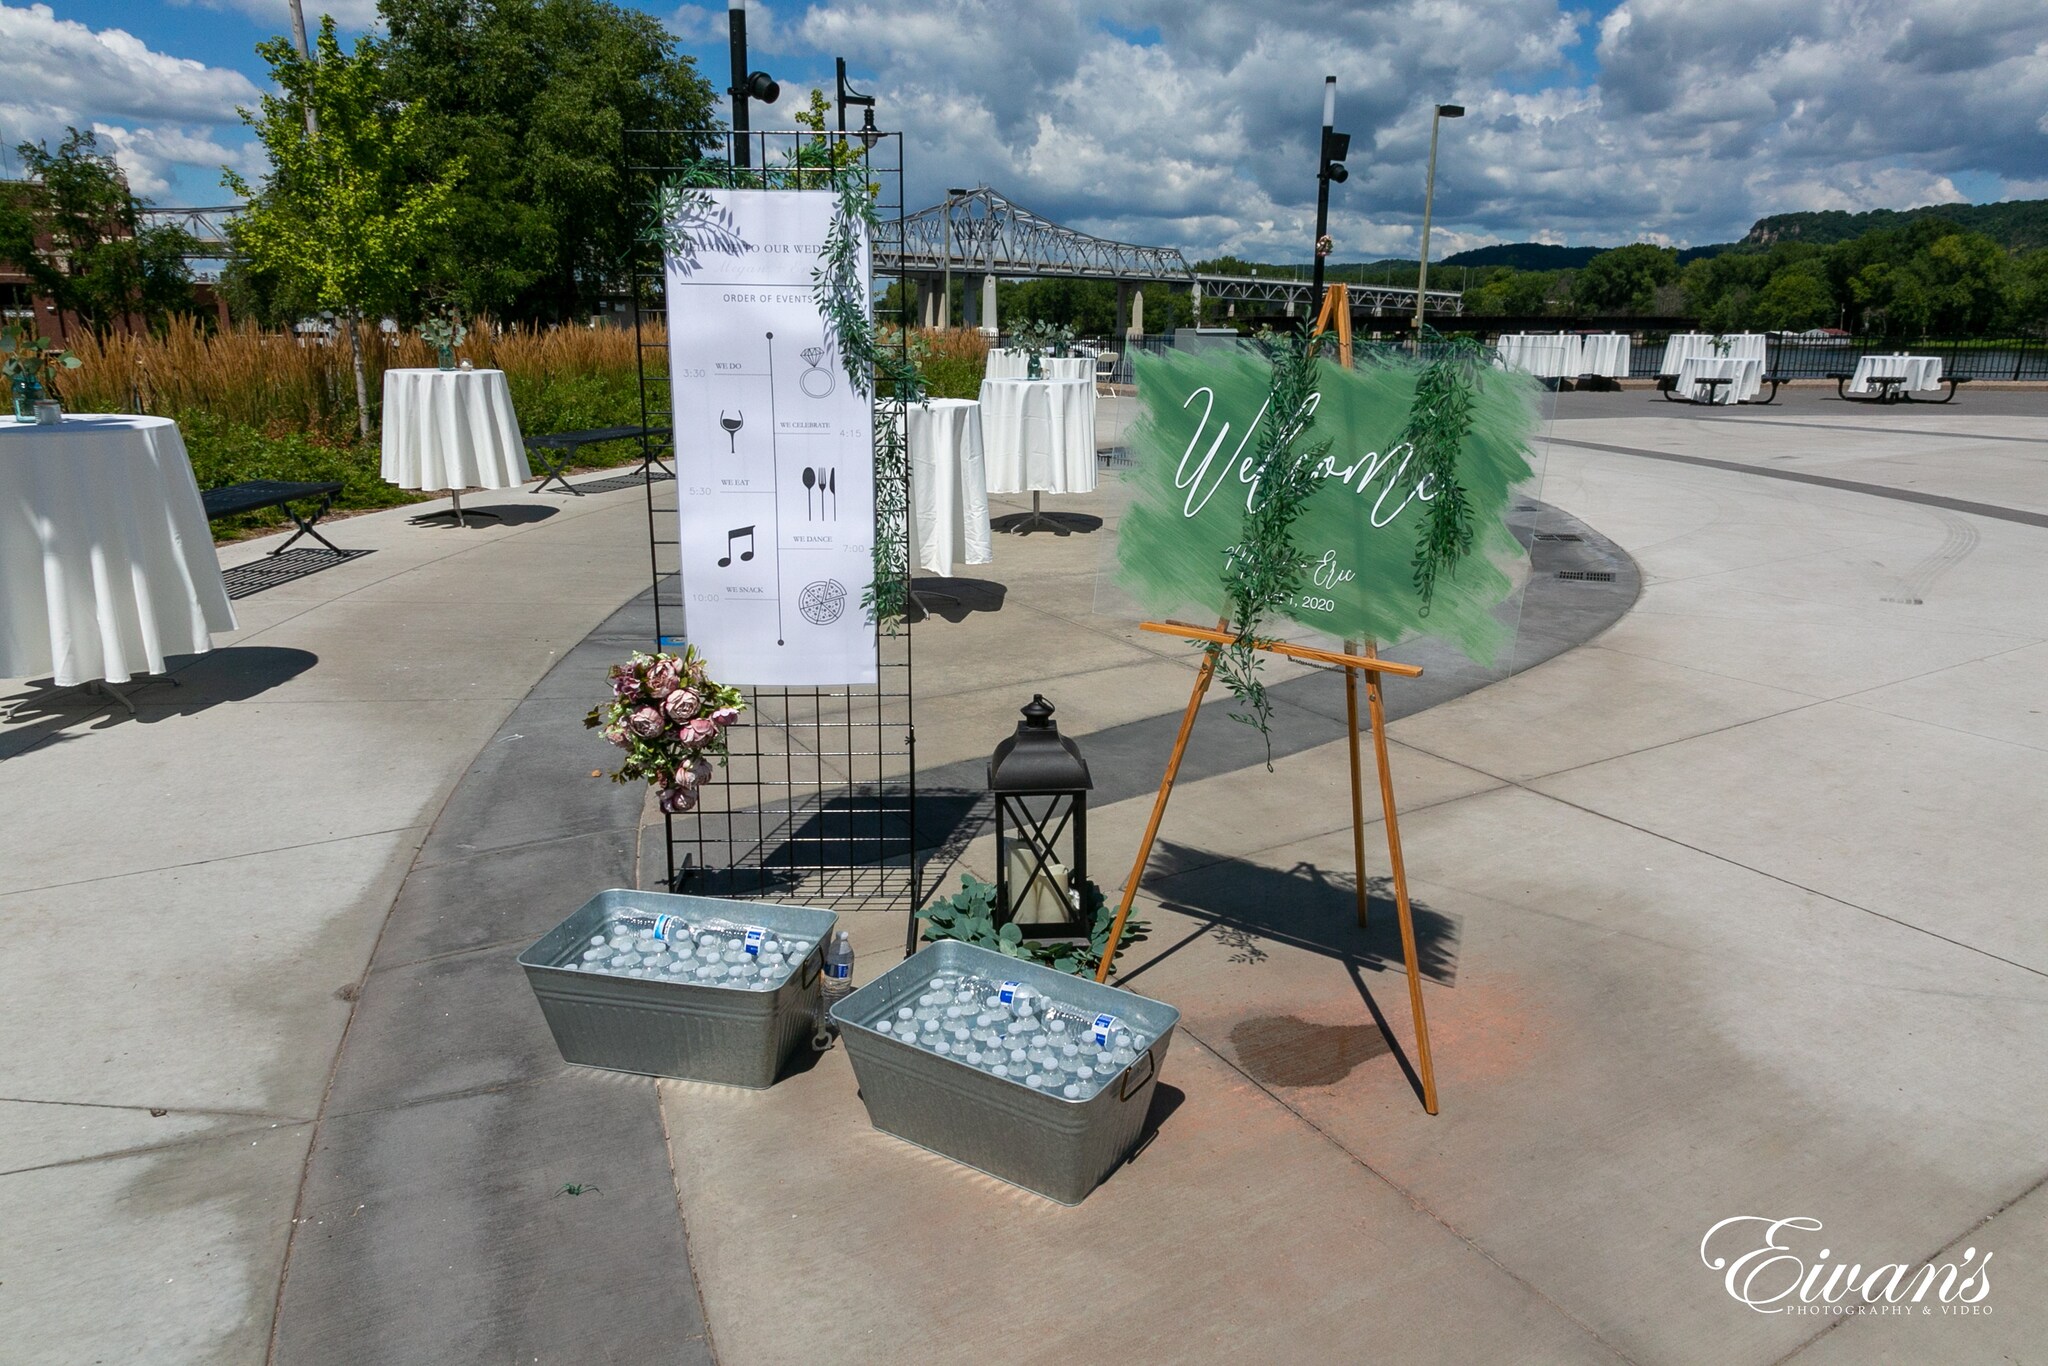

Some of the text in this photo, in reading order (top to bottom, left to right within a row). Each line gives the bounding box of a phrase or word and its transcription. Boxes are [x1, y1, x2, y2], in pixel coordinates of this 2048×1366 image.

[764, 244, 790, 253] OUR
[723, 294, 813, 303] ORDER OF EVENTS
[715, 362, 742, 370] WE DO
[683, 368, 706, 378] 3:30
[839, 429, 862, 438] 4:15
[689, 487, 712, 496] 5:30
[843, 544, 865, 553] 7:00
[1313, 549, 1356, 590] Eric
[693, 593, 720, 602] 10:00
[1302, 595, 1335, 612] 2020
